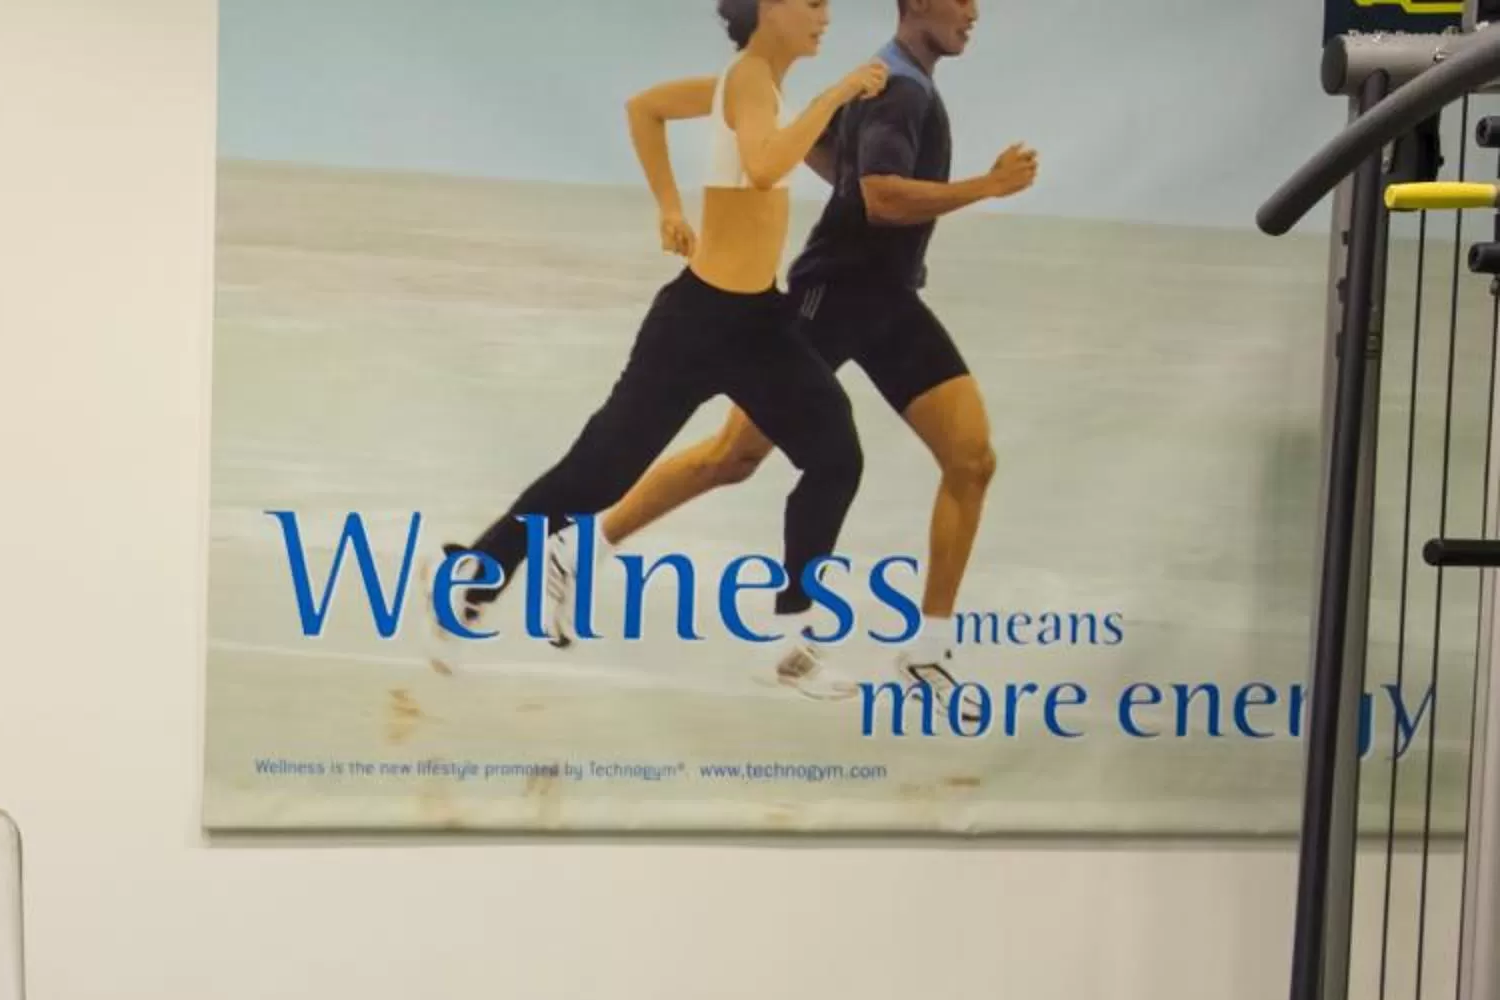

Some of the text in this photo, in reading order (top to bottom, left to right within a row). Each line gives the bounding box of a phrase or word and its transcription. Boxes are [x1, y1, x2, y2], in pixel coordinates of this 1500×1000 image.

[263, 510, 1124, 645] Wellness means
[858, 681, 1087, 739] more
[255, 758, 325, 775] Wellness
[331, 759, 343, 775] is
[349, 759, 373, 776] the
[379, 762, 410, 776] new
[416, 759, 478, 781] lifestyle
[484, 760, 559, 781] promoted
[563, 760, 583, 780] by
[699, 761, 887, 782] www.technogym.com
